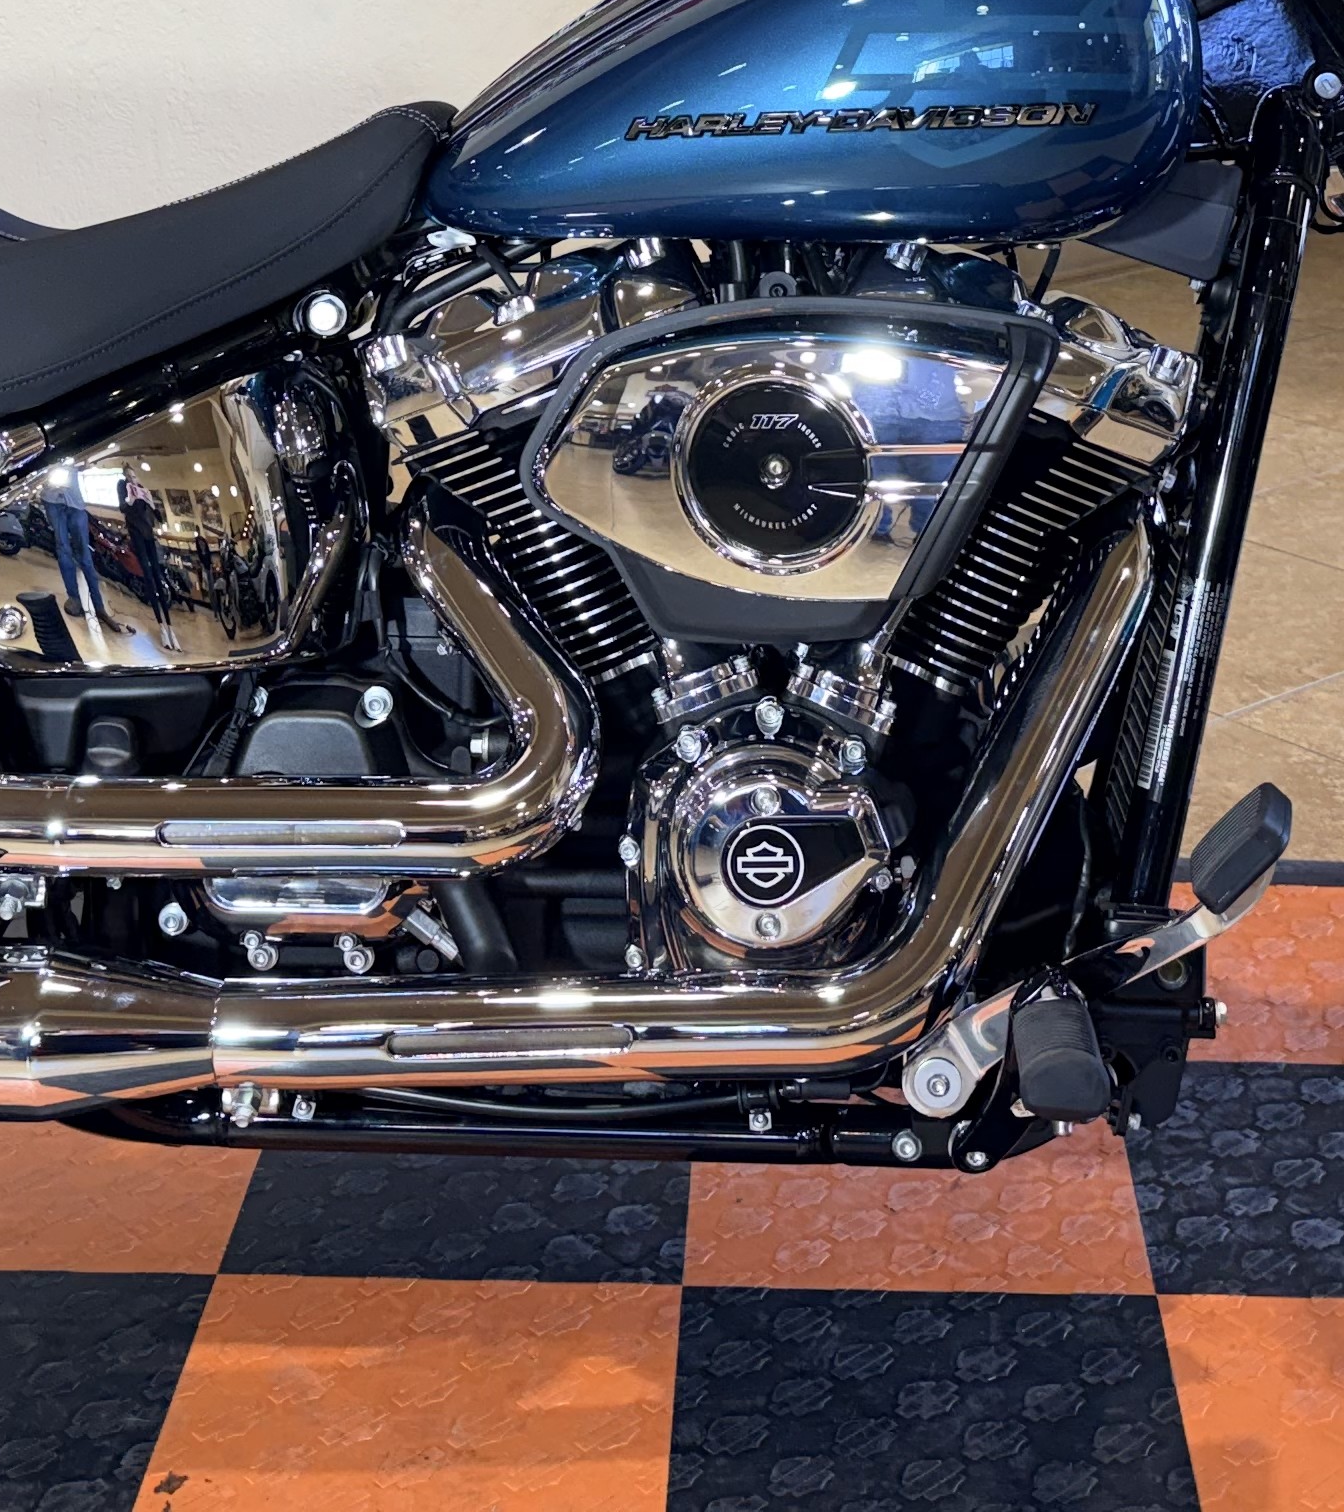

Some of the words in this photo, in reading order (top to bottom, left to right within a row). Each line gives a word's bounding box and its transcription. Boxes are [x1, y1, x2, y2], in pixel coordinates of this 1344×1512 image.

[722, 422, 745, 448] CUBIC
[749, 413, 800, 430] 117
[797, 422, 822, 449] INCHES
